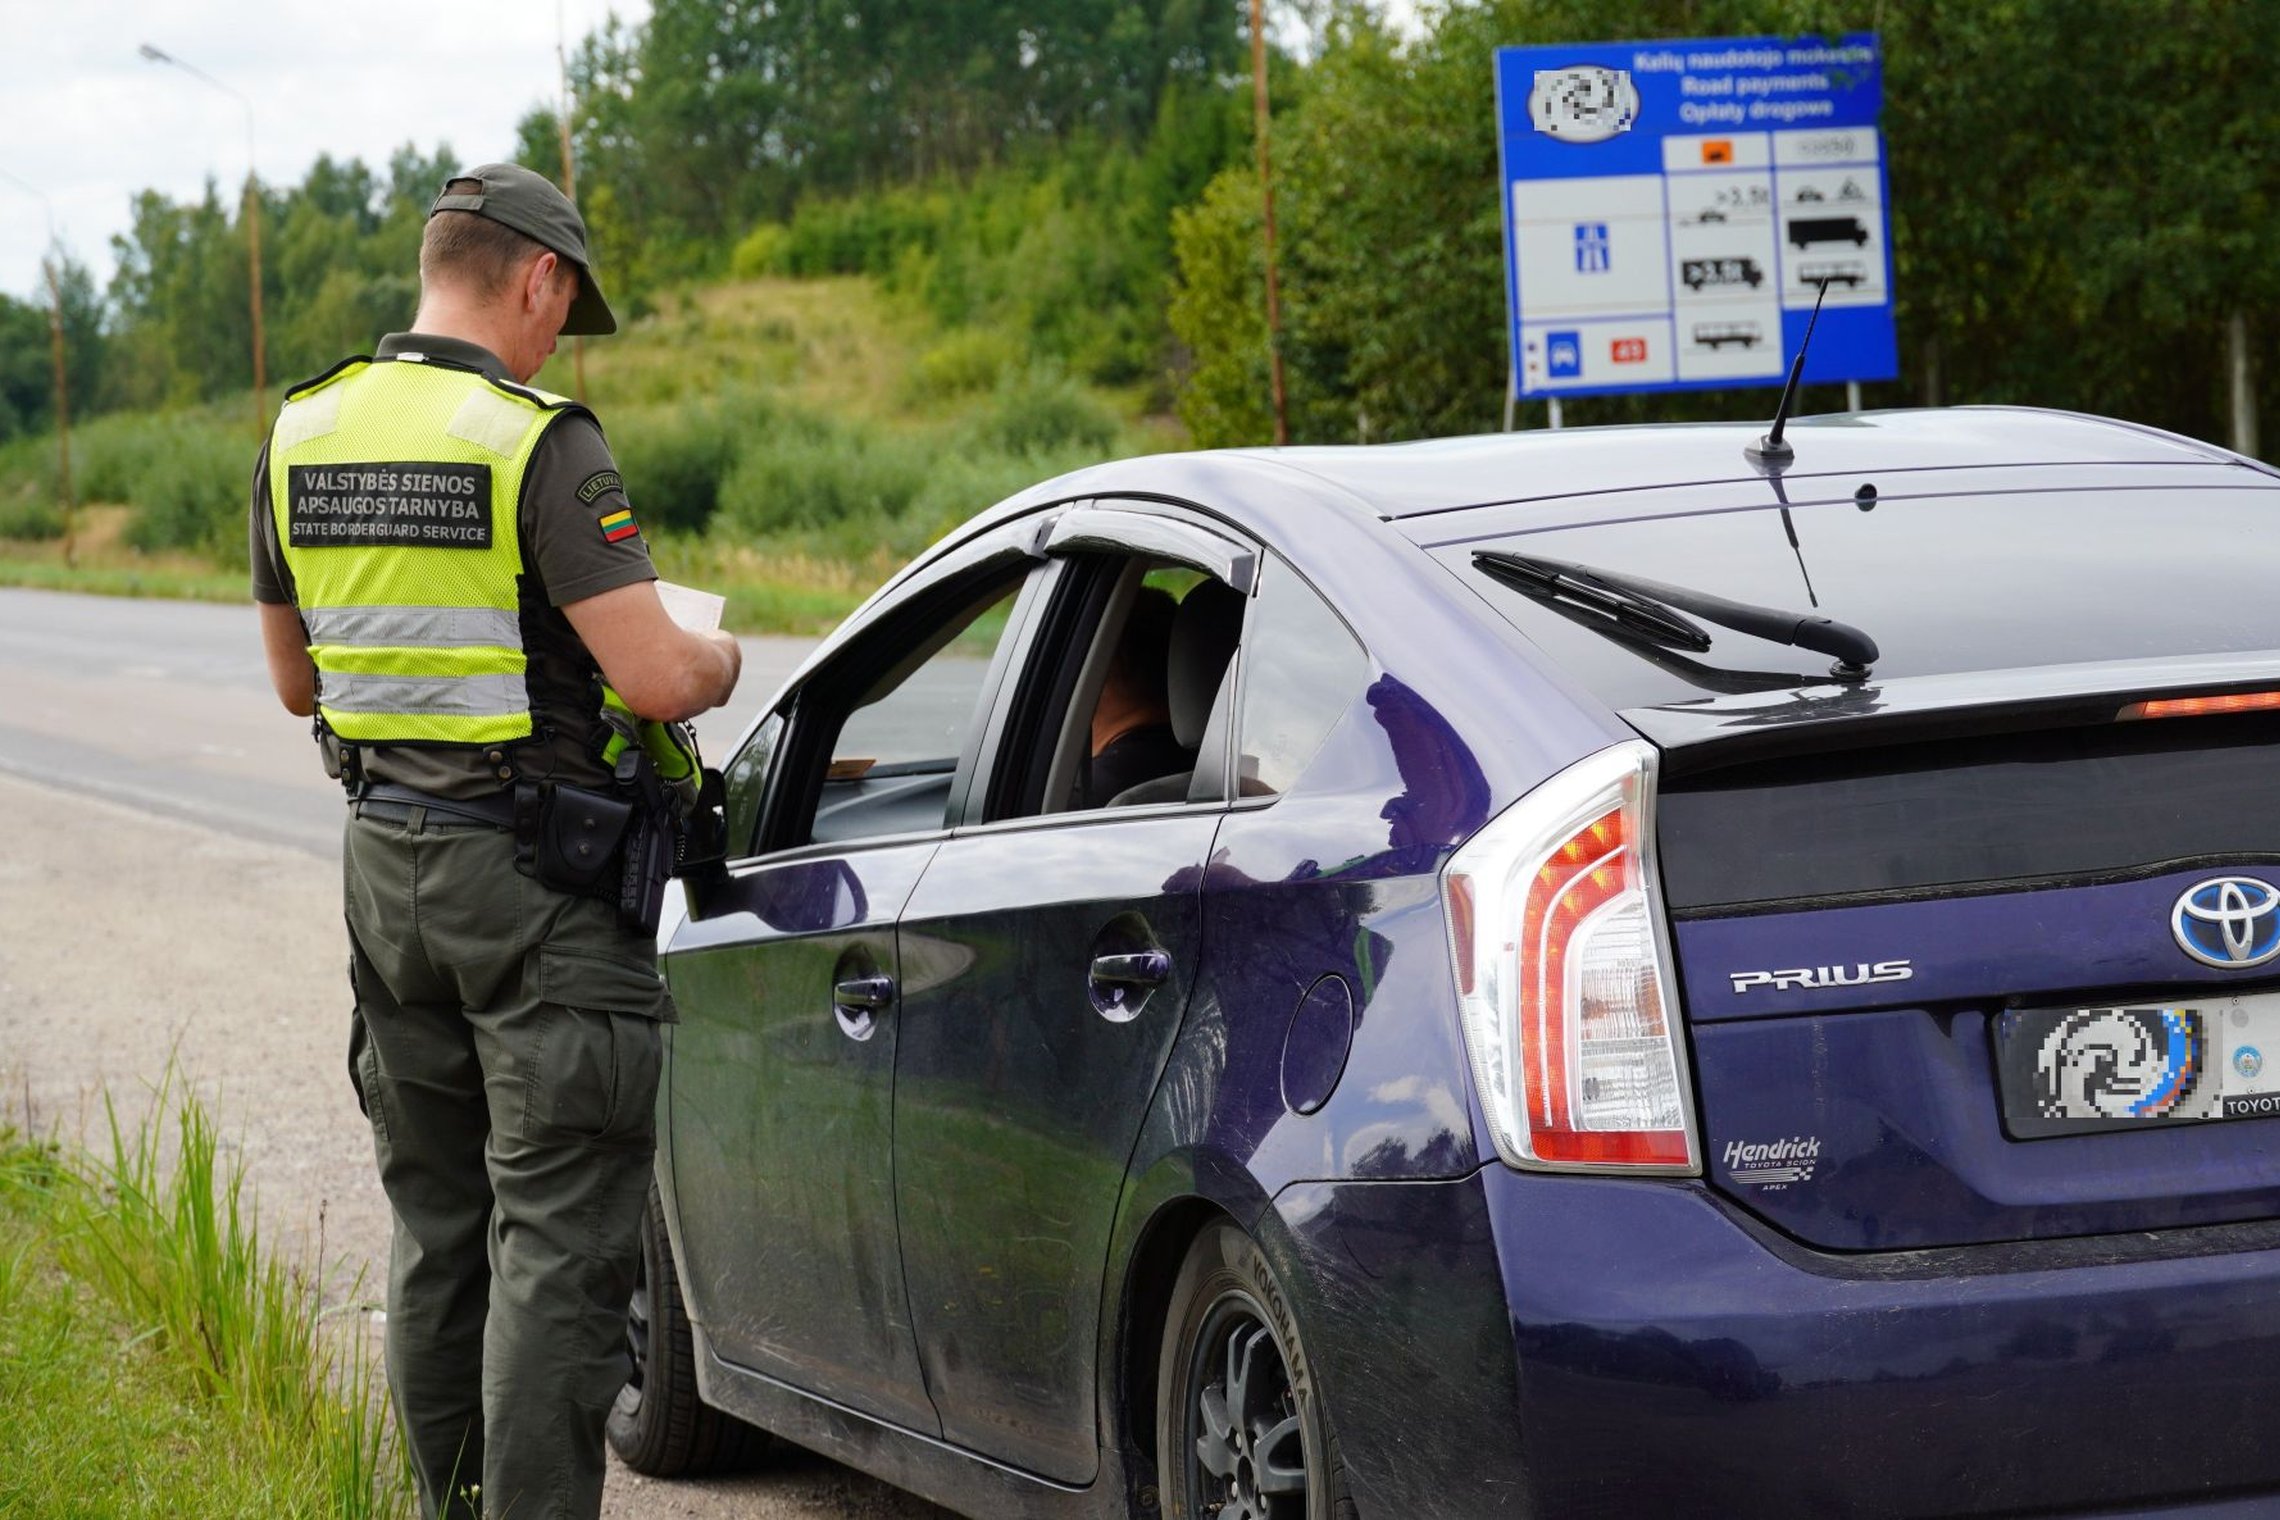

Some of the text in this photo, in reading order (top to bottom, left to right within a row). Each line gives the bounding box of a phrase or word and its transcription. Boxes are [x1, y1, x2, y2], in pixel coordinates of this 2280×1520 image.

[1681, 74, 1830, 97] Road payments
[304, 468, 475, 495] VALSTYBĖS SIENOS
[297, 496, 480, 519] APSAUGOS TARNYBA
[292, 523, 328, 536] STATE
[422, 525, 485, 541] SERVICE
[1729, 960, 1913, 994] PRIUS
[1723, 1136, 1820, 1169] Hendrick
[1744, 1159, 1816, 1169] TOYOTA SCION
[1253, 1254, 1308, 1409] YOKOHAMA
